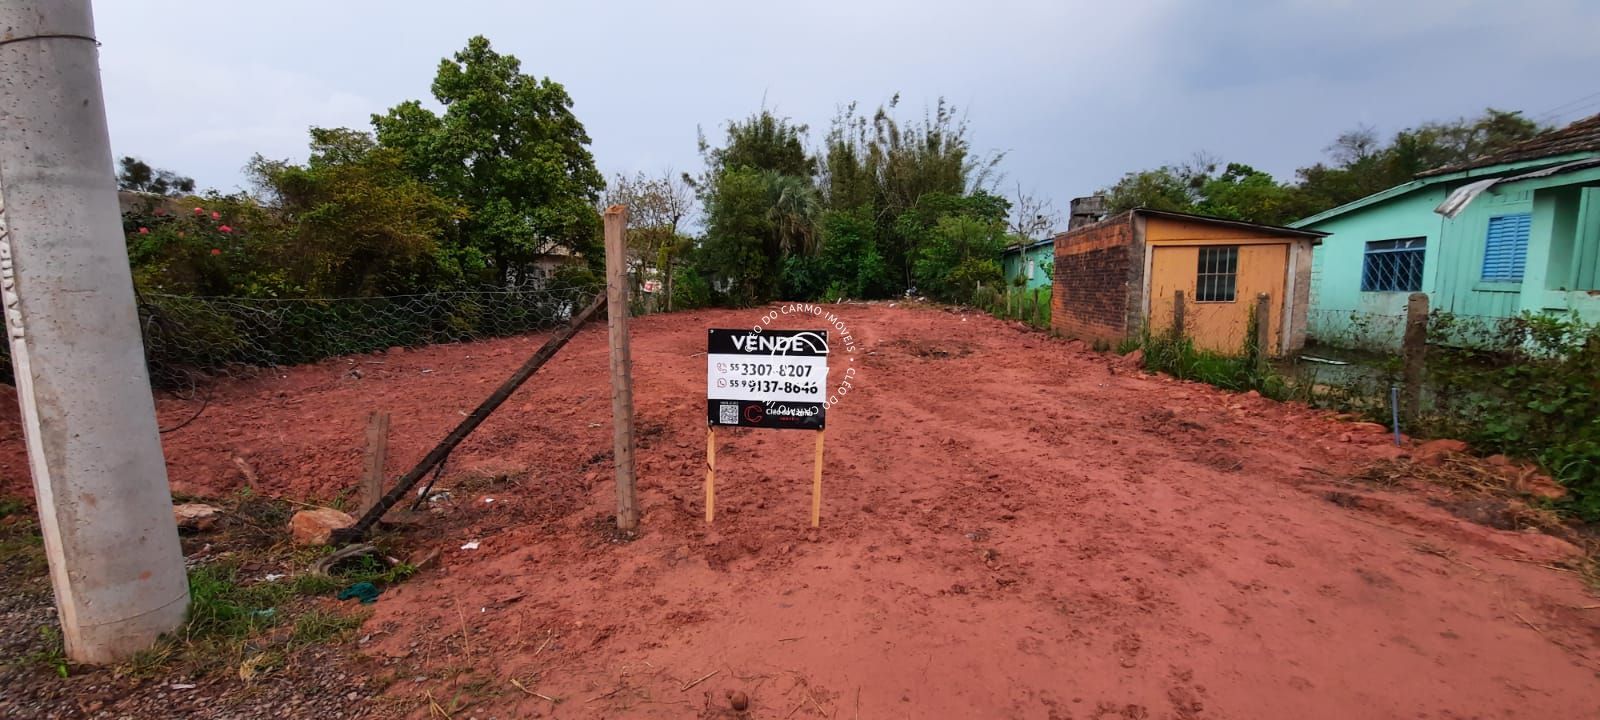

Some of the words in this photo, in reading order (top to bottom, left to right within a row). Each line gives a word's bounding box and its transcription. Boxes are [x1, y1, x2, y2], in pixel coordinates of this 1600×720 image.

[730, 335, 804, 352] VENDE
[729, 363, 740, 371] 55
[729, 379, 740, 388] 55
